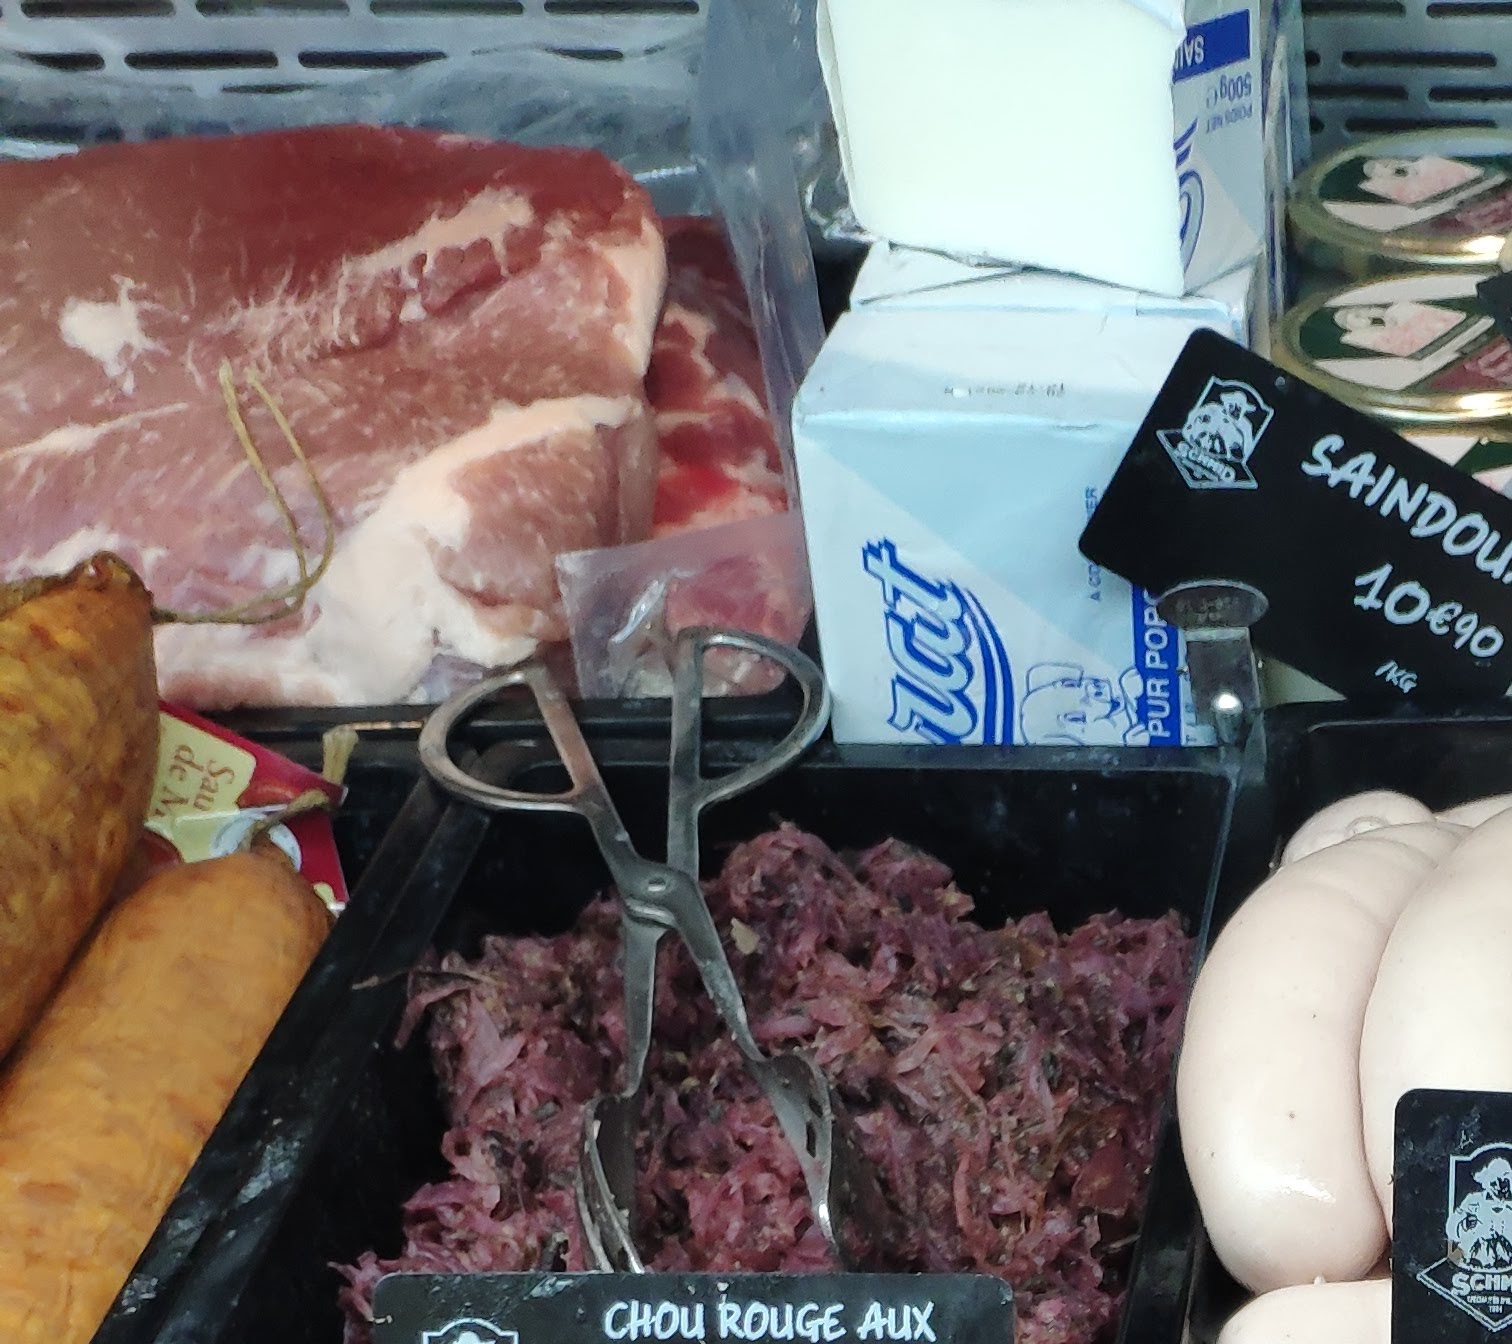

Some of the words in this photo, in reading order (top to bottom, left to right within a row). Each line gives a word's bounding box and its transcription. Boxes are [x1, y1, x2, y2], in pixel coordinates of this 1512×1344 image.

[1353, 562, 1505, 659] 10€90
[1146, 677, 1171, 738] PUR
[604, 1300, 706, 1341] CHOU
[718, 1302, 847, 1343] ROUGE
[856, 1301, 937, 1342] AUX
